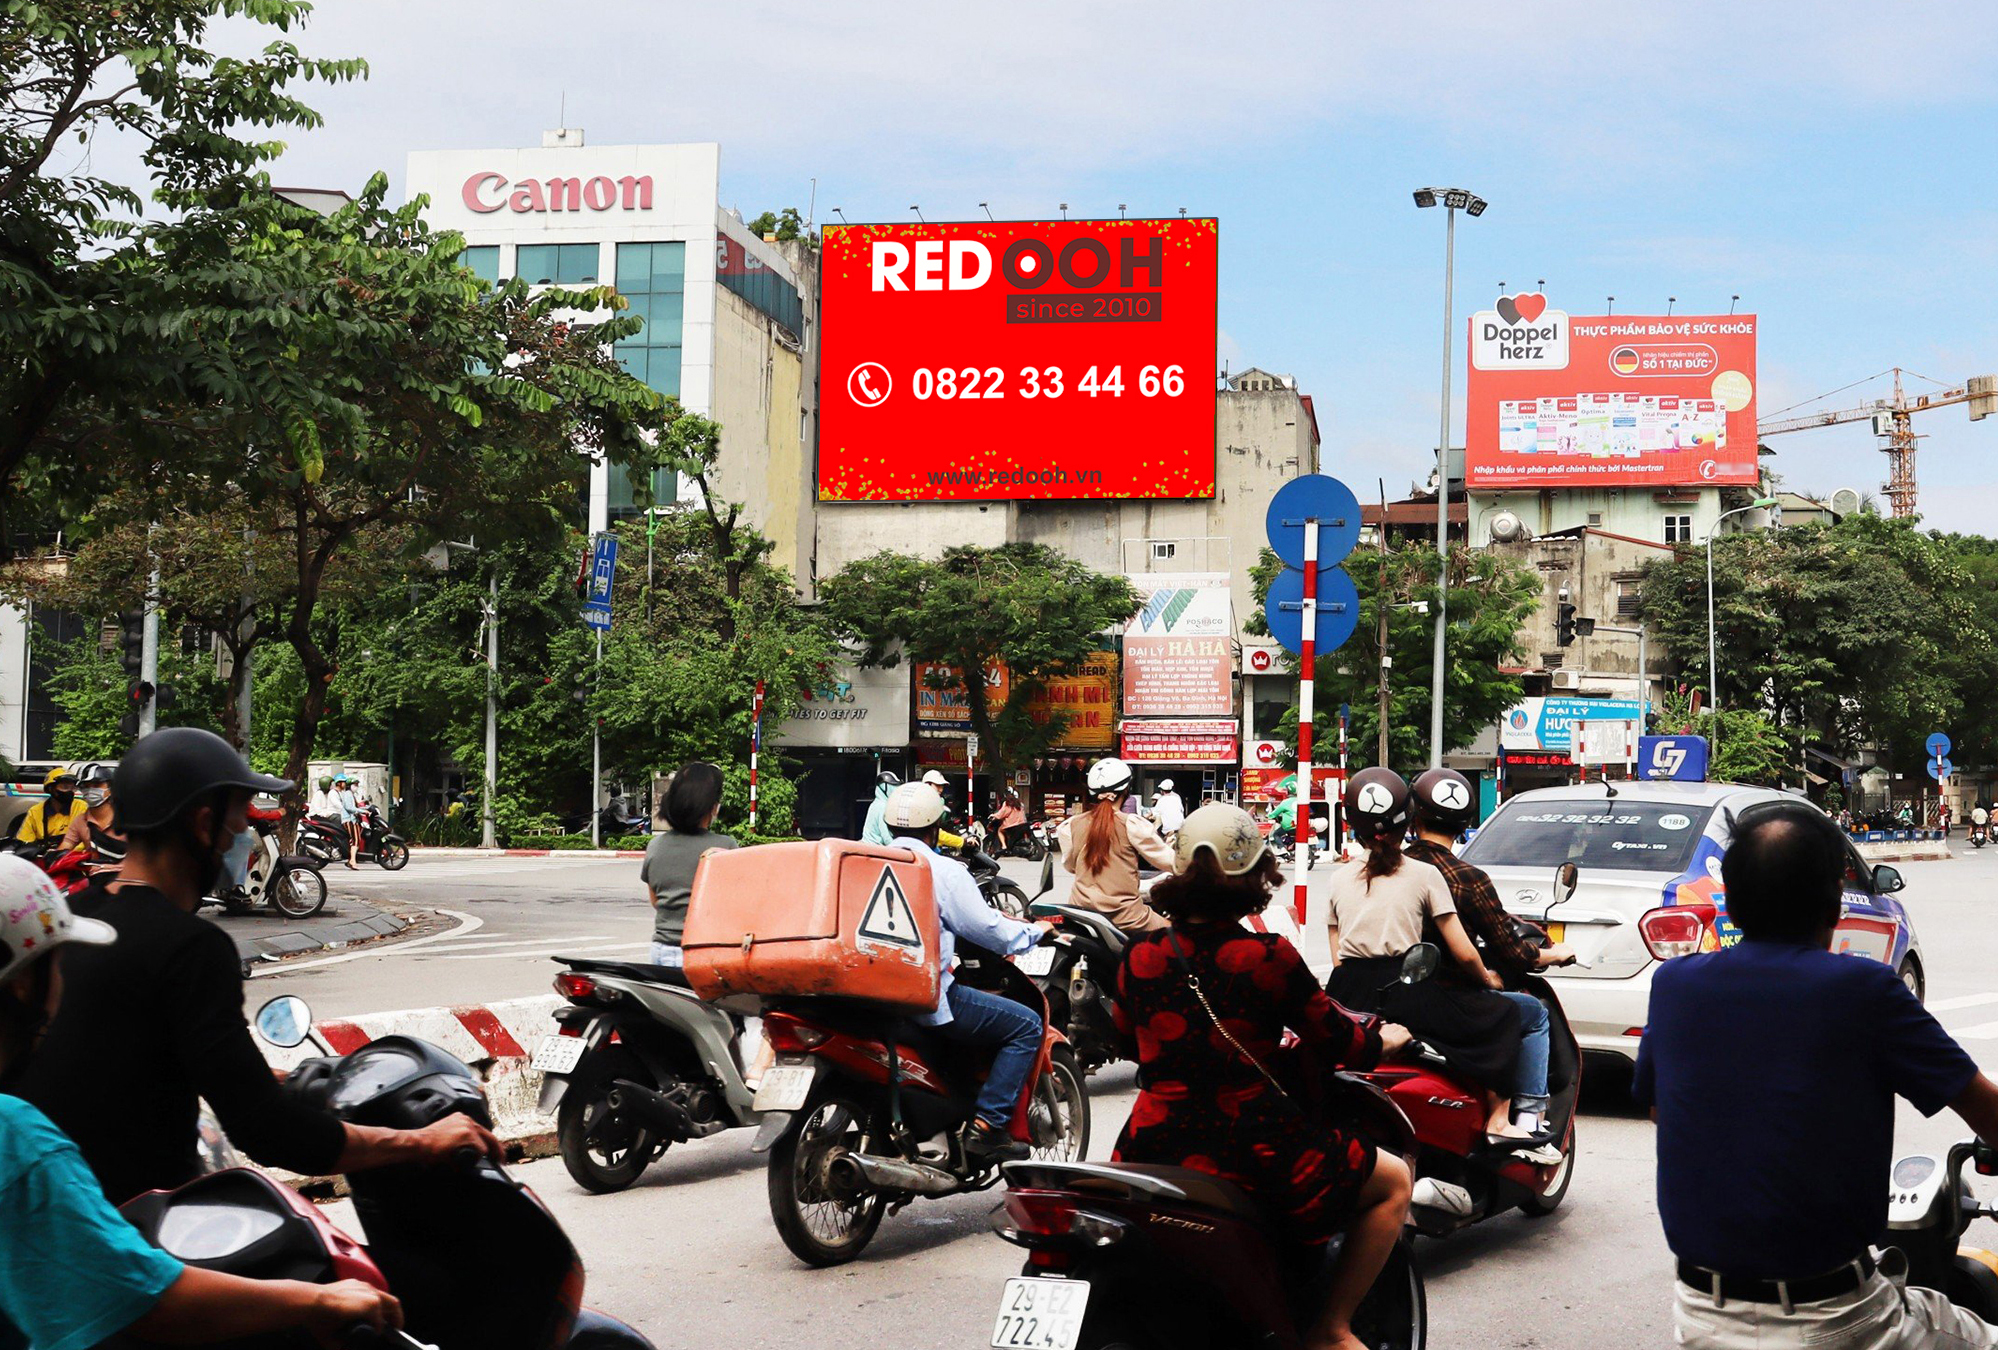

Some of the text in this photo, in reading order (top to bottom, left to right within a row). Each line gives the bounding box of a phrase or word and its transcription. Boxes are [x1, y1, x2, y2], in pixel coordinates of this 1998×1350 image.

[462, 171, 653, 213] Canon
[1016, 297, 1152, 319] since 2010
[1483, 323, 1558, 345] Doppel
[1573, 321, 1753, 338] THỰC PHẨM BẢO VỆ SỨC KHỎE
[1500, 342, 1544, 359] herz
[1642, 357, 1657, 369] SỐ
[1659, 360, 1664, 369] 1
[1666, 359, 1682, 370] TẠI
[912, 364, 1185, 400] 0822 33 44 66
[927, 466, 1102, 486] www.redooh.vn
[1474, 465, 1495, 475] Nhập
[1496, 464, 1515, 473] khẩu
[1566, 464, 1587, 473] chính
[1622, 464, 1665, 472] Mastertran
[1128, 638, 1227, 658] ĐẠI LÝ HÀ HÀ
[920, 690, 936, 707] IN
[814, 708, 827, 719] TO
[829, 708, 849, 719] GET
[851, 708, 868, 719] FIT
[1546, 706, 1590, 716] ĐẠI LÝ
[1652, 741, 1687, 776] G7
[1562, 815, 1587, 824] 32
[1588, 815, 1614, 824] 32
[1615, 816, 1642, 825] 32
[1662, 818, 1686, 826] 1188
[1011, 1283, 1074, 1315] 29-E2
